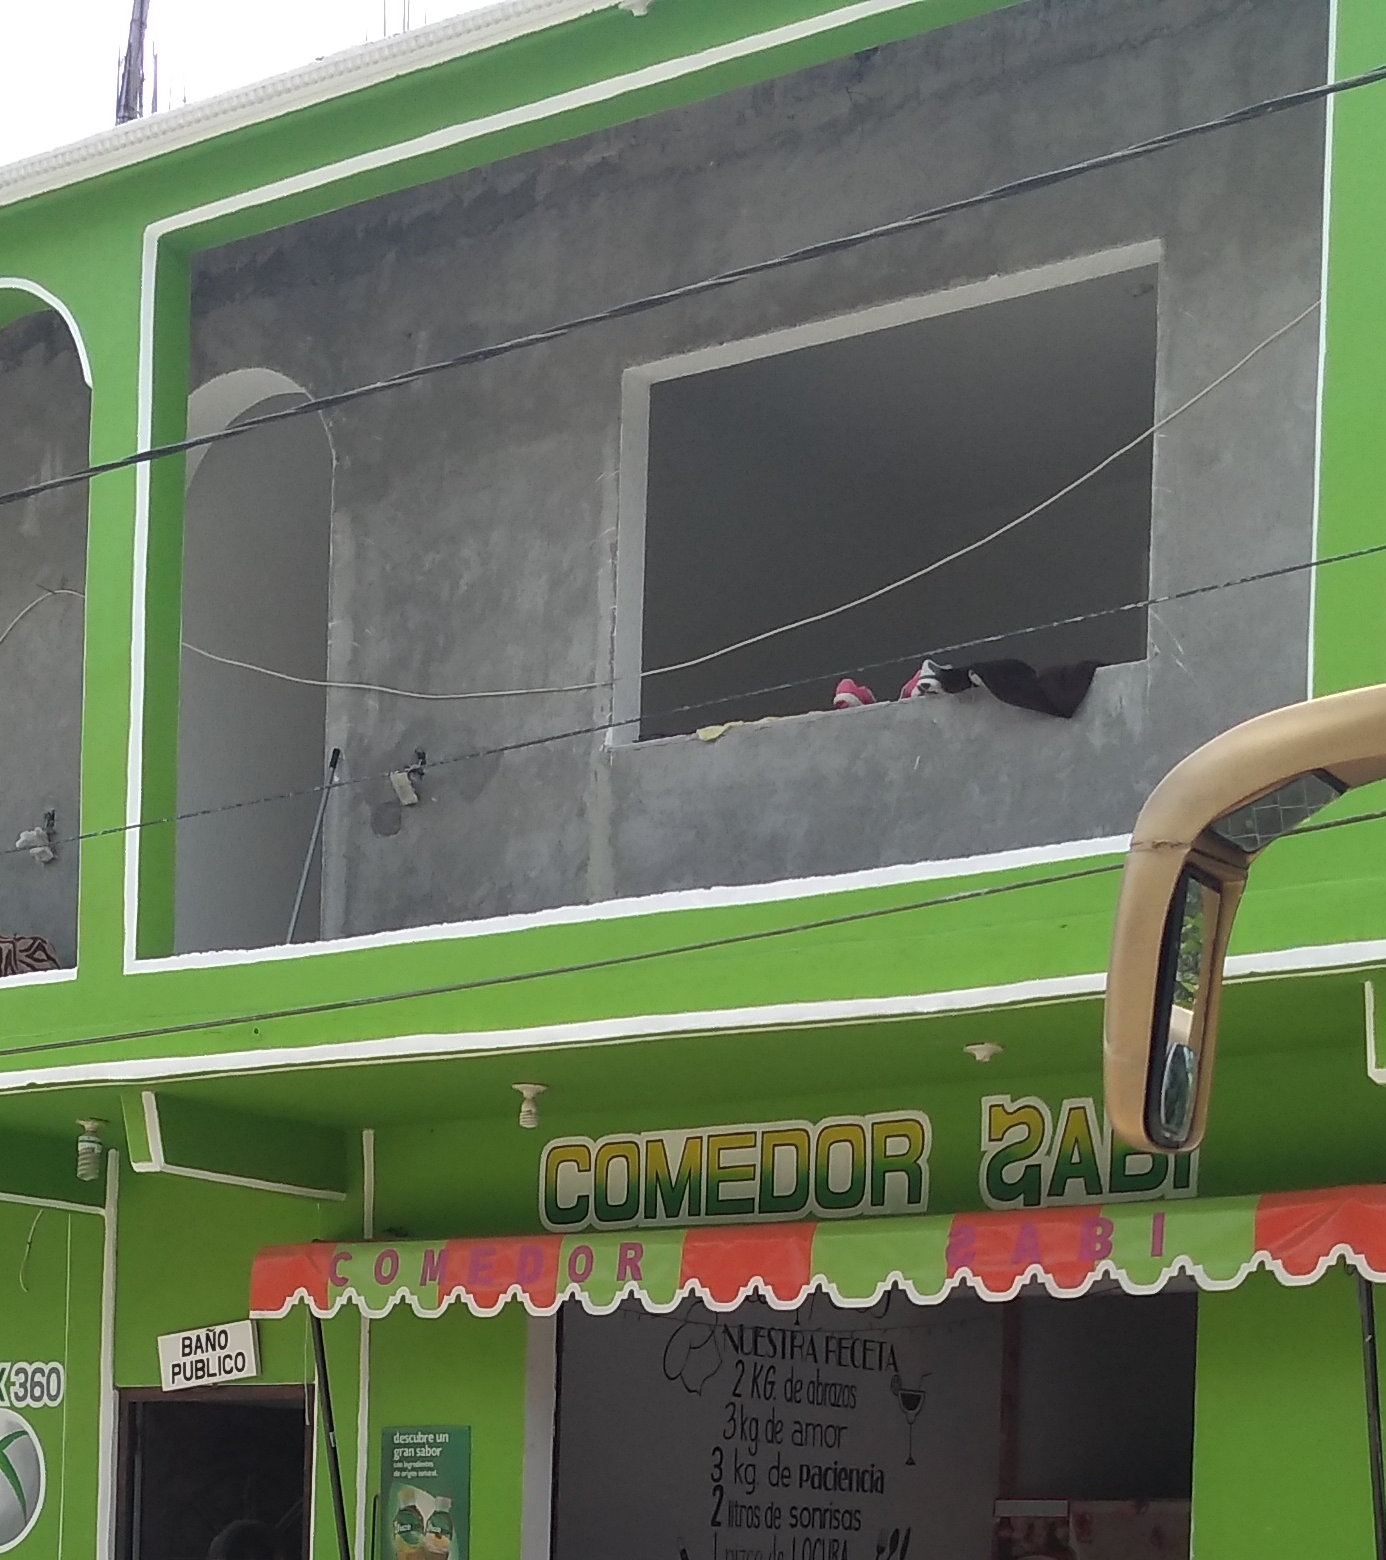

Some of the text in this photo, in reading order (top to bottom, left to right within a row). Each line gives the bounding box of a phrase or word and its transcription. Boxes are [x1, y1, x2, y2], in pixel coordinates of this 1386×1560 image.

[544, 1117, 925, 1225] COMEDOR
[328, 1242, 644, 1287] COMEDOR
[180, 1328, 229, 1358] BAÑO
[723, 1323, 899, 1372] NUESTRA RECETA
[13, 1366, 62, 1404] 360
[171, 1351, 246, 1385] PUBLICO
[732, 1359, 856, 1409] 2 KG. de abrazos
[393, 1431, 449, 1444] descubre un
[723, 1402, 736, 1440] 3
[765, 1406, 783, 1444] de
[791, 1420, 848, 1449] amor
[393, 1445, 442, 1460] gran sabor
[711, 1446, 724, 1483] 3
[768, 1451, 791, 1487] de
[799, 1461, 884, 1494] paciencia
[711, 1484, 861, 1531] 2 litros de sonrisas
